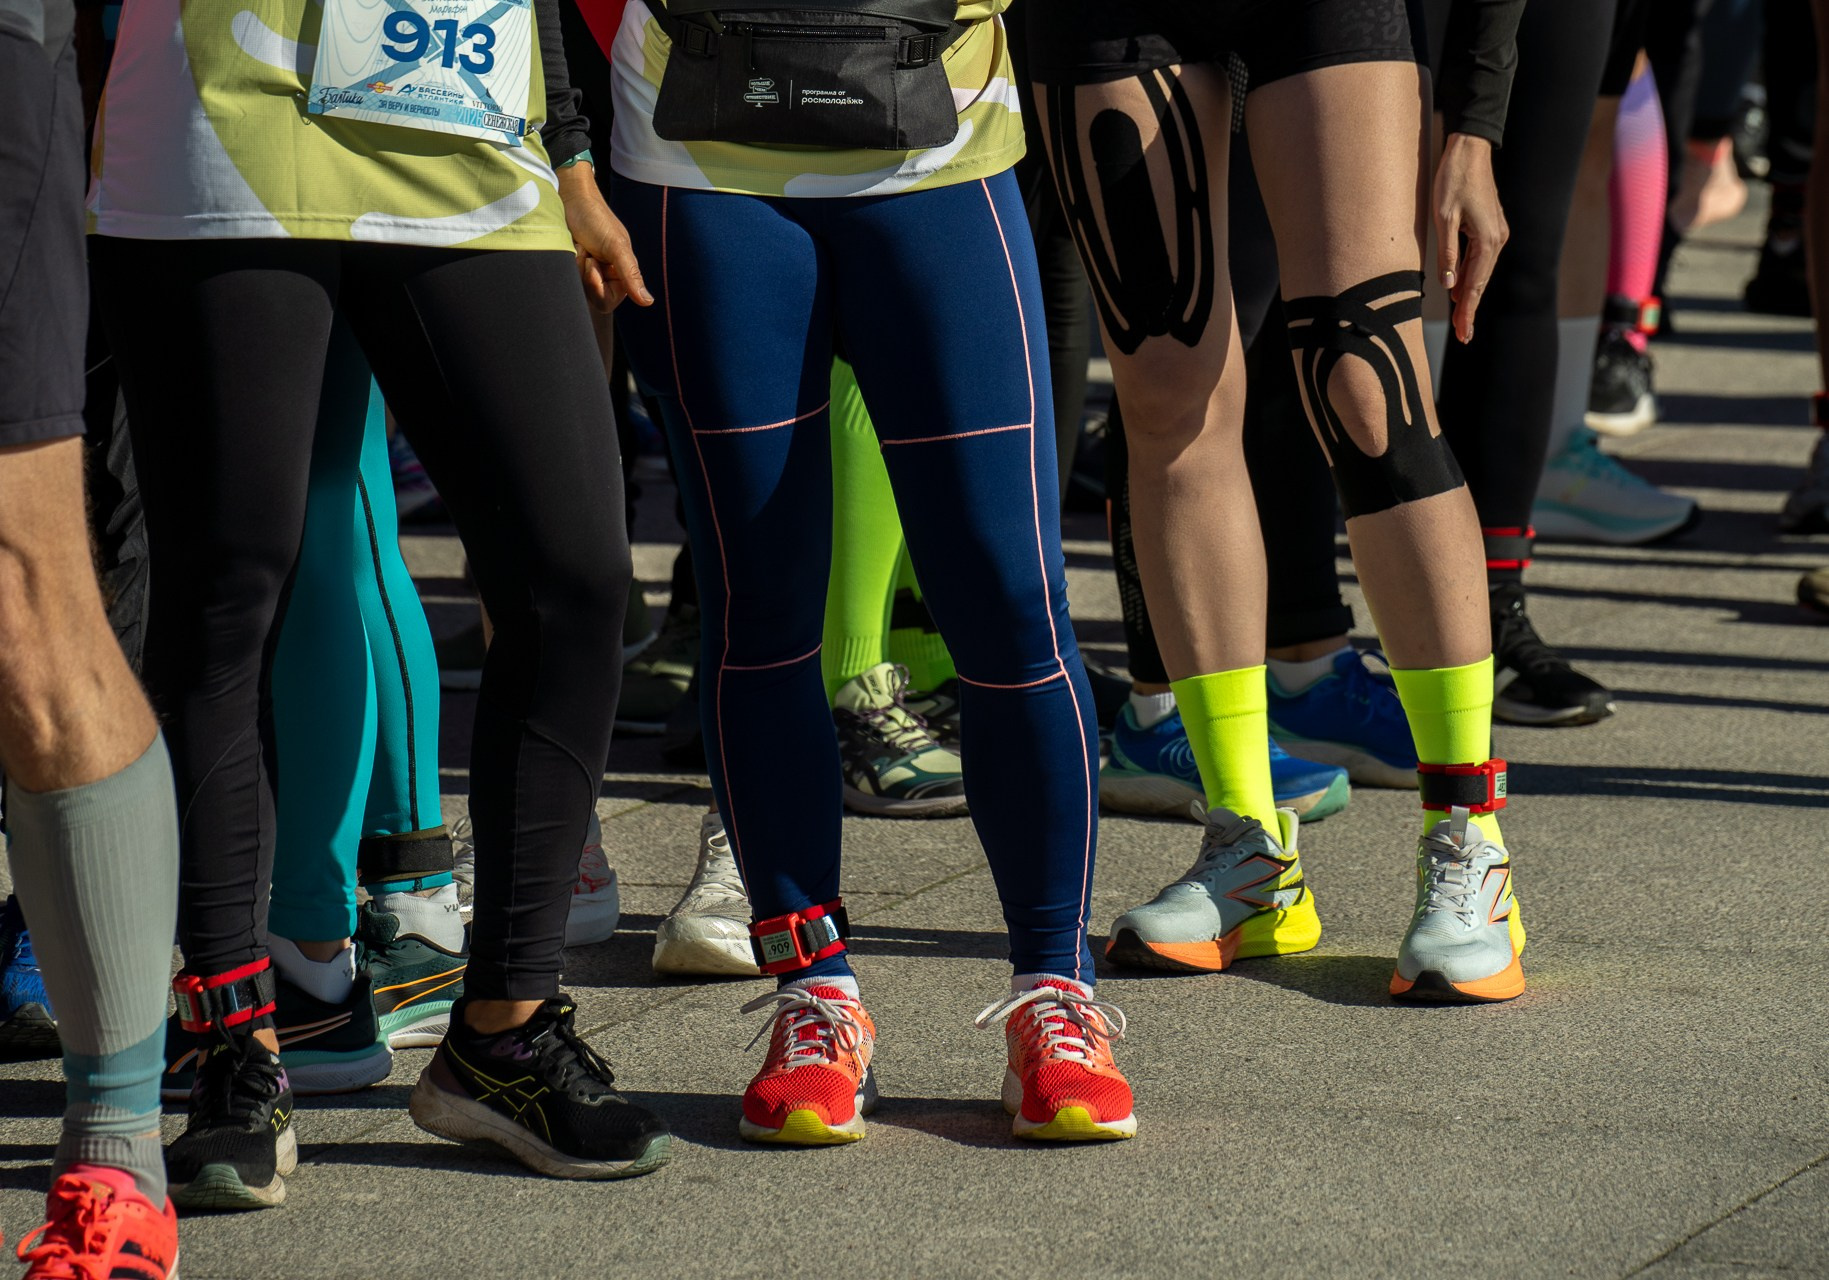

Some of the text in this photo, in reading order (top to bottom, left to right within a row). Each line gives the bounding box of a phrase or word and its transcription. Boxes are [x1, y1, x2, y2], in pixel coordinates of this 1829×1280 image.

[381, 11, 496, 75] 913
[418, 87, 465, 99] БАССЕЙНЫ
[770, 941, 790, 955] 909
